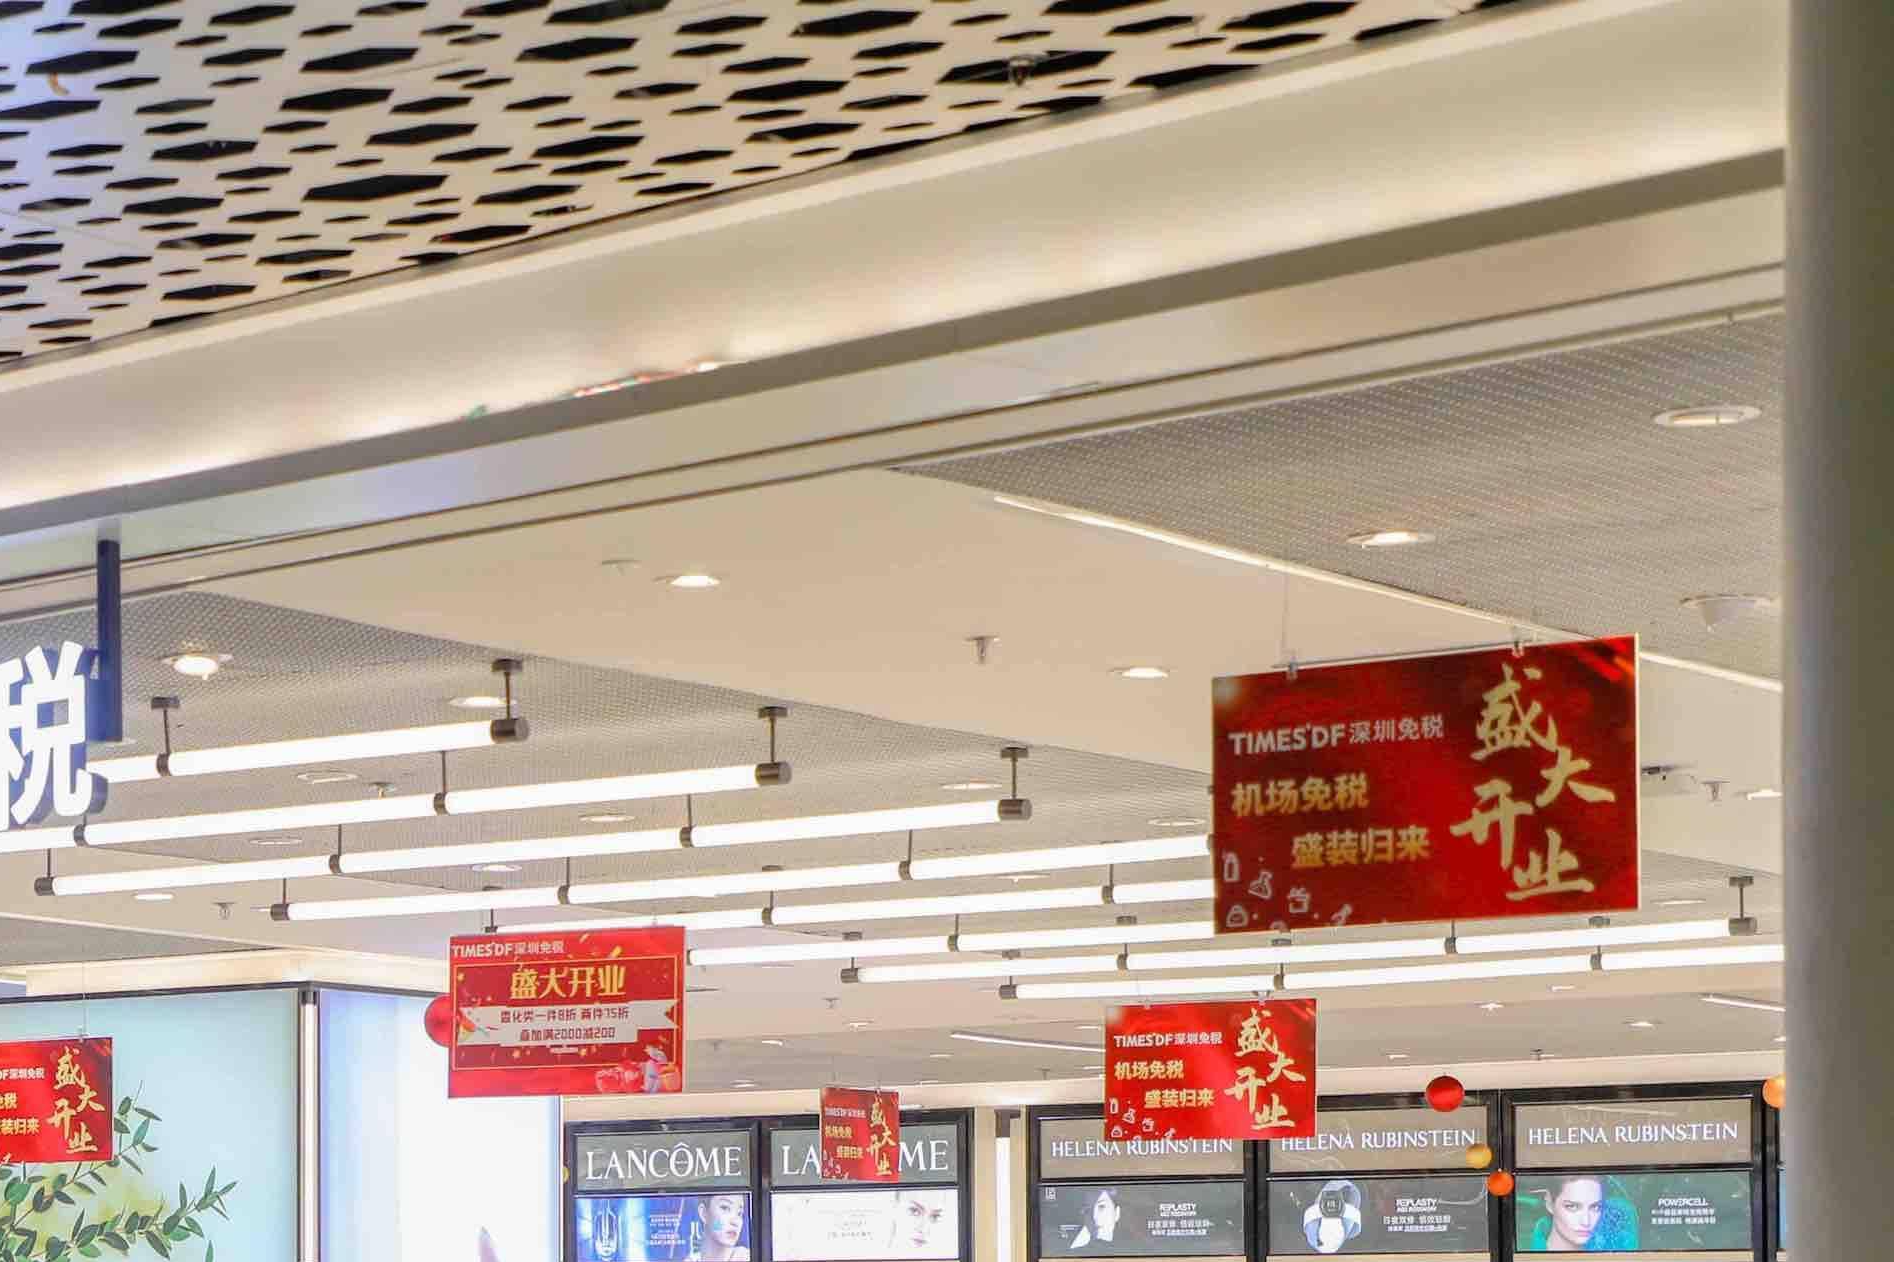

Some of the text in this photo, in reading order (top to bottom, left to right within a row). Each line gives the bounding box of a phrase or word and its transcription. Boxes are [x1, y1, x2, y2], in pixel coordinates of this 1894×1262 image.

[1349, 714, 1444, 744] 深圳免税
[1232, 773, 1369, 817] 机场免税
[1291, 825, 1432, 869] 盛装归来
[509, 965, 626, 1000] 盛大开业
[1114, 1060, 1184, 1080] 机场免税
[1052, 1138, 1233, 1158] HELENA RUBINSTEIN
[1282, 1129, 1475, 1151] HELENA RUBINSTEIN
[1529, 1123, 1738, 1146] HELENA RUBINSTEIN
[586, 1142, 742, 1180] LANCÔME
[782, 1140, 949, 1175] LAME
